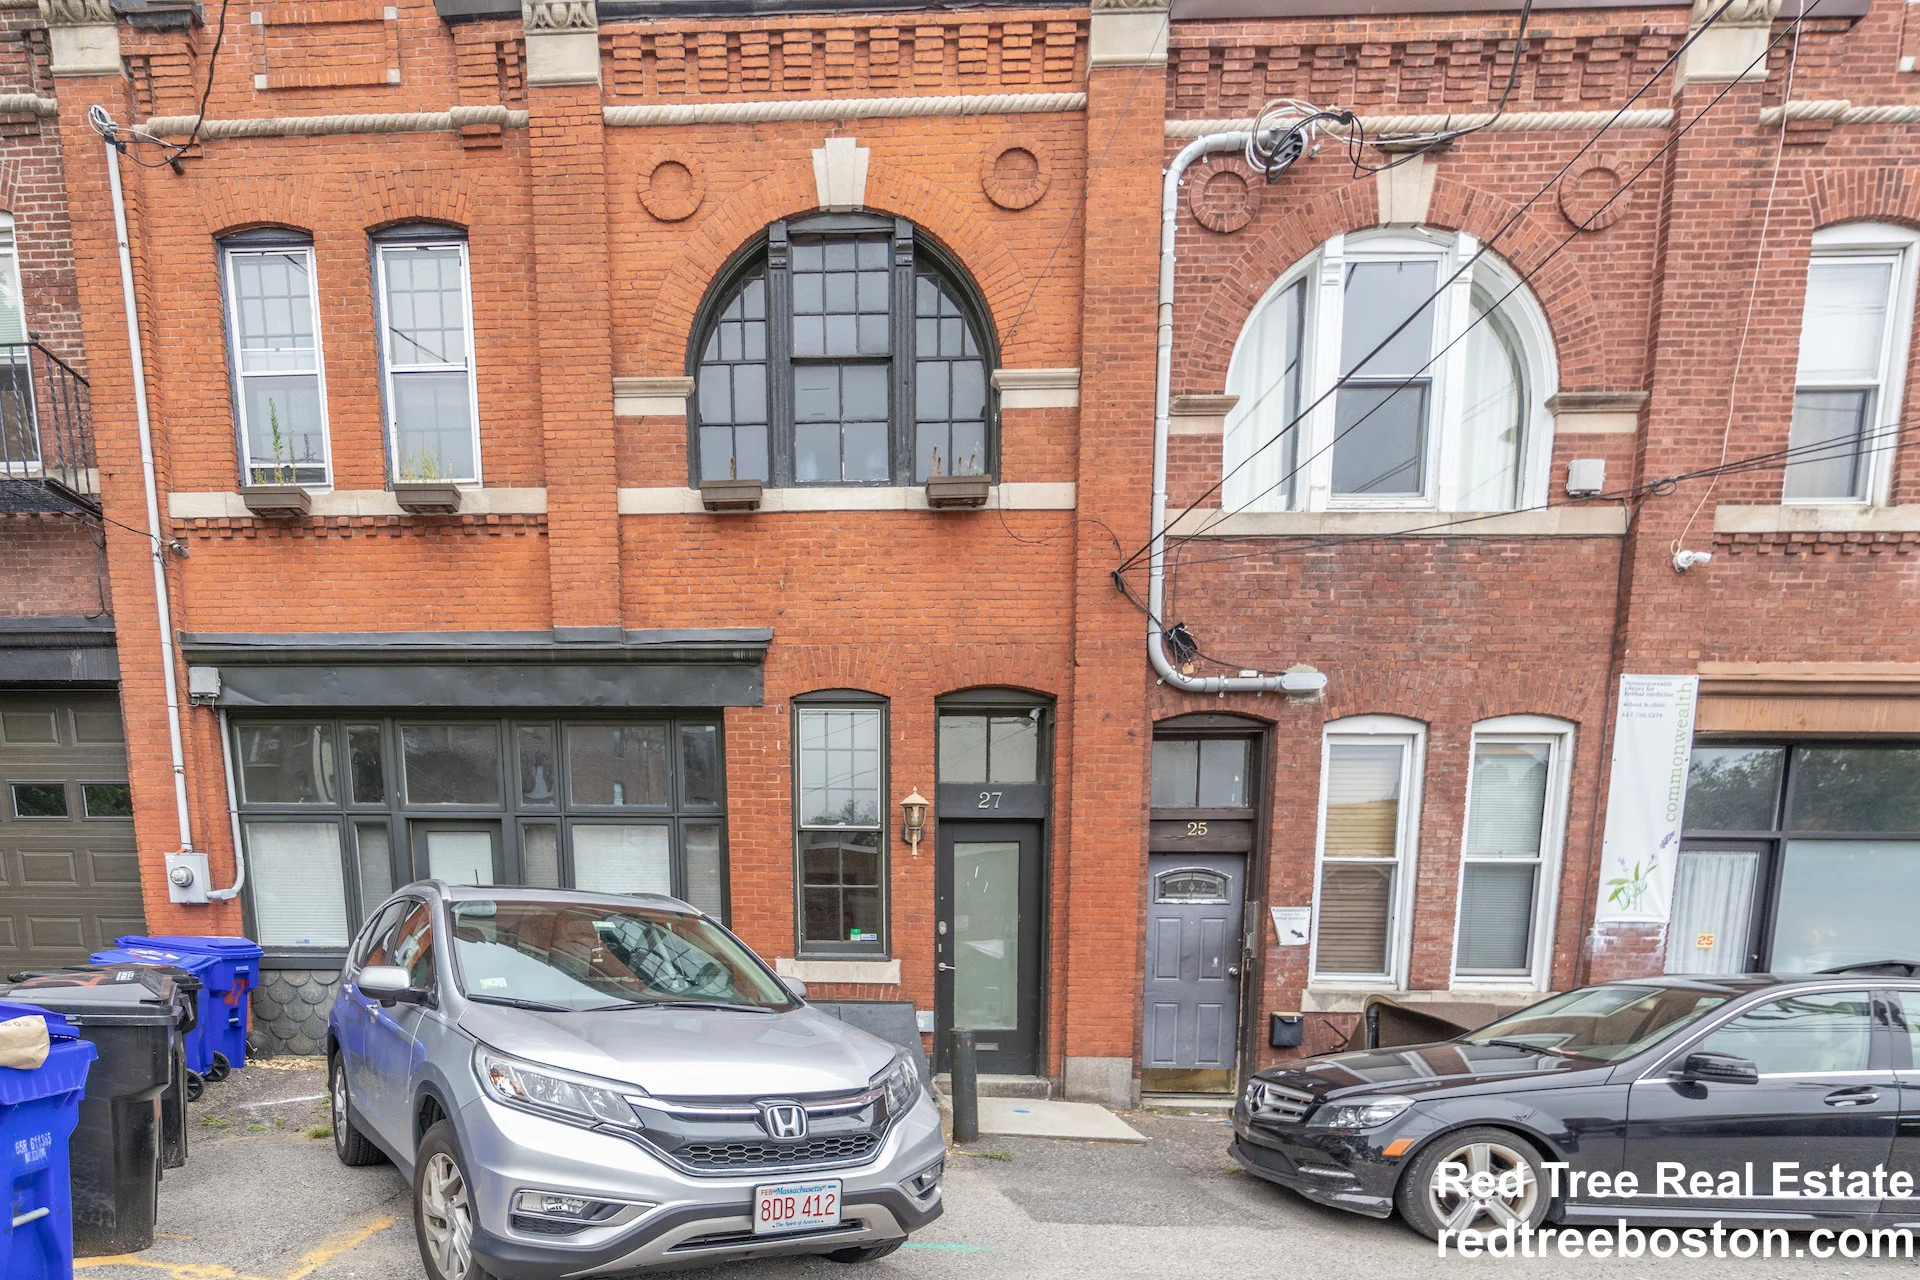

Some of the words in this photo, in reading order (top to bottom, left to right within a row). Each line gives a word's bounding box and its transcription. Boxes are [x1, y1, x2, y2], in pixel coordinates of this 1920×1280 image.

[1666, 682, 1692, 822] commonwealth
[978, 792, 1003, 809] 27
[1187, 821, 1208, 836] 25
[1697, 935, 1714, 946] 25
[776, 1185, 823, 1195] Massachusetts
[761, 1197, 795, 1221] 8DB
[802, 1193, 836, 1217] 412
